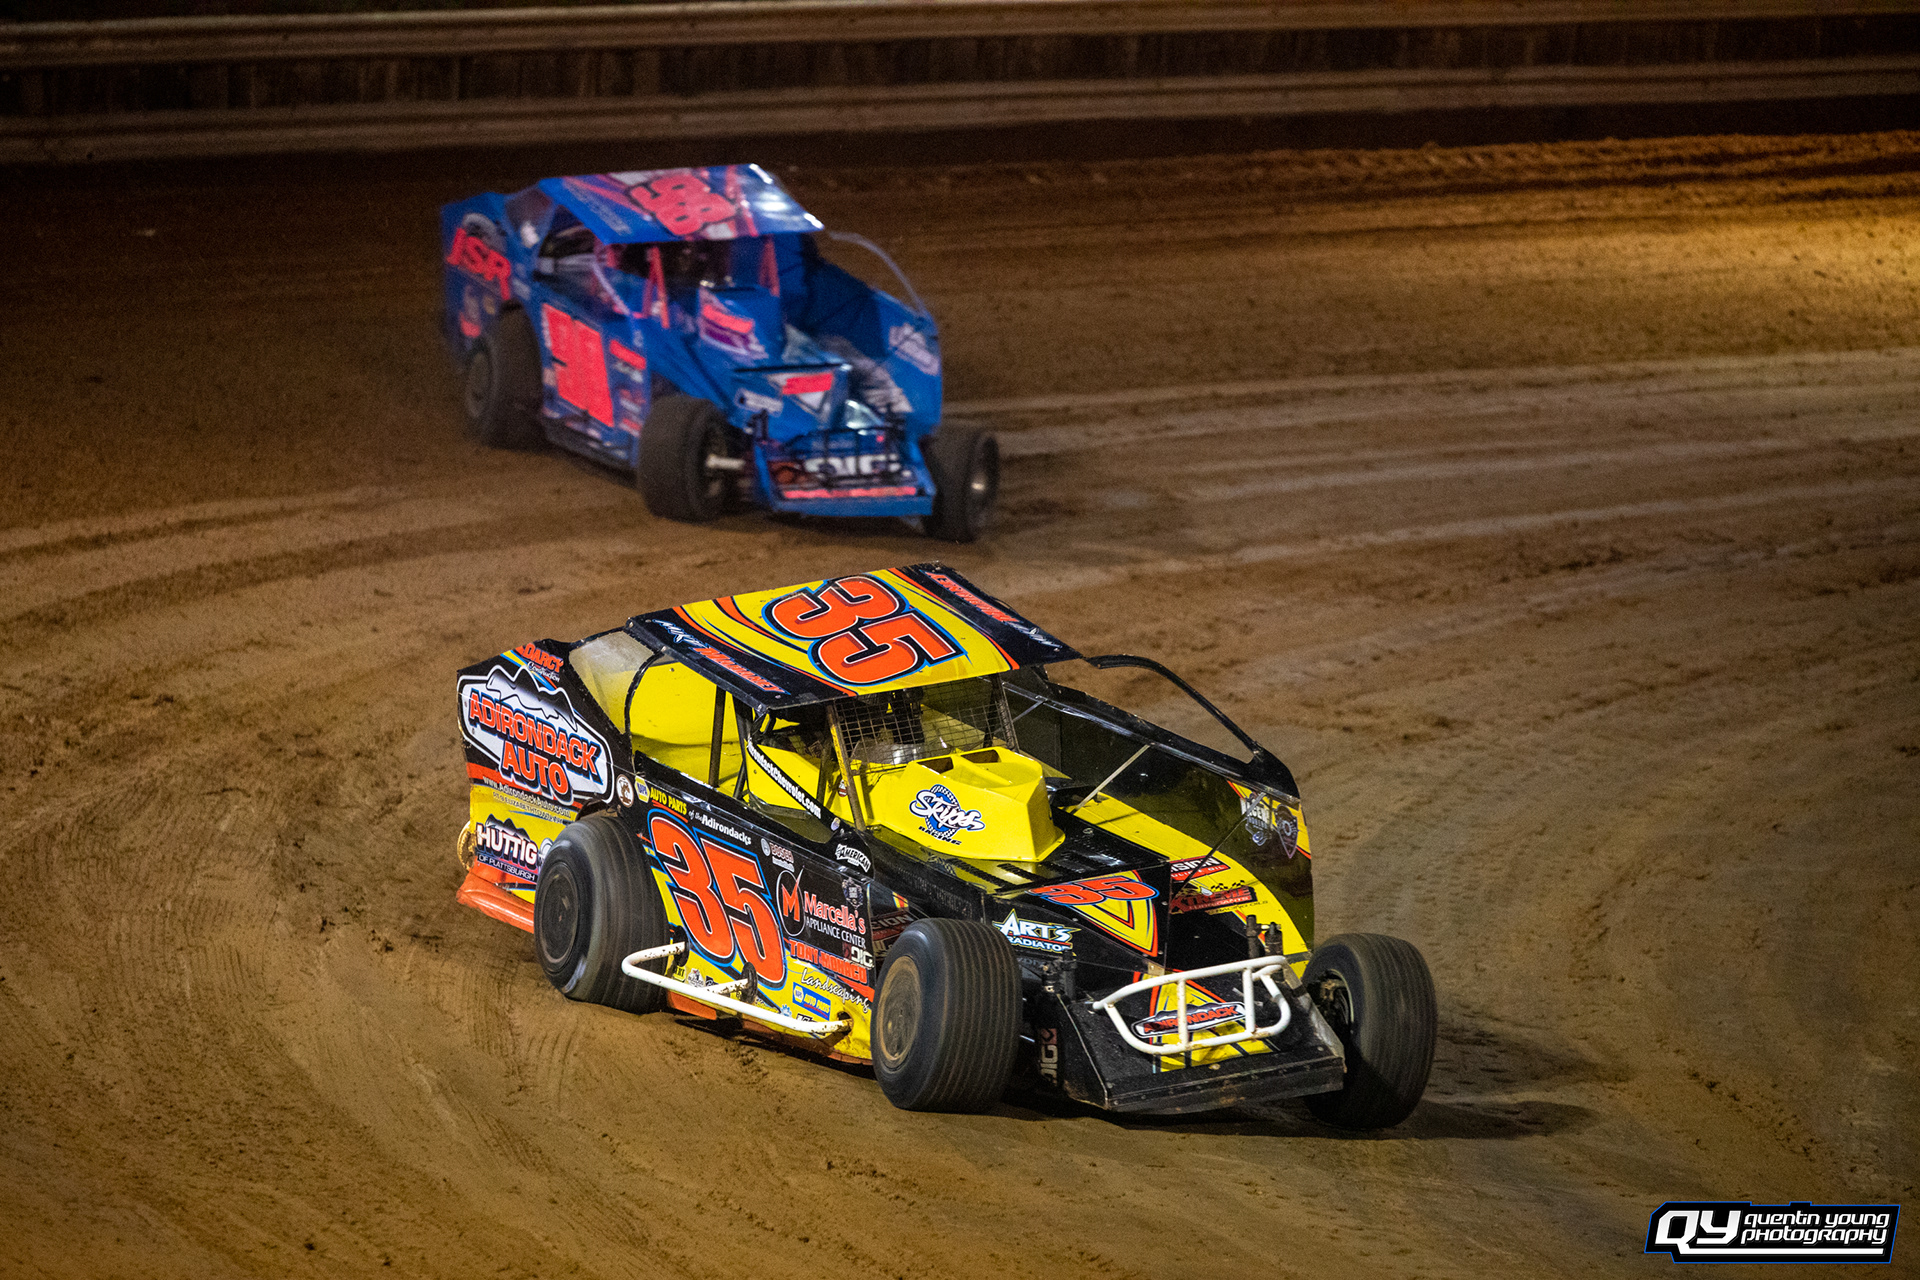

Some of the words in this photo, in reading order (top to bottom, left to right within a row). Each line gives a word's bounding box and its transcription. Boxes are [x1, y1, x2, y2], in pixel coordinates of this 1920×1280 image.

[772, 575, 957, 684] 35
[522, 642, 564, 673] DARCY
[469, 690, 600, 778] ADIRONDACK
[502, 740, 571, 796] AUTO
[650, 787, 667, 806] AUTO
[668, 795, 687, 815] PARTS
[476, 823, 538, 866] HUTTIG
[701, 814, 752, 846] Adirondacks
[918, 826, 962, 845] RACING
[478, 854, 488, 862] OF
[488, 857, 536, 881] PLATTSBURGH
[838, 846, 870, 872] AMERICAN
[650, 816, 785, 985] 35
[1028, 876, 1156, 905] 35
[803, 890, 866, 935] Marcella's
[993, 911, 1074, 942] ART'S
[804, 916, 841, 940] APPLIANCE
[840, 930, 867, 950] CENTER
[788, 938, 819, 965] TONY
[801, 967, 871, 1014] Landscaping
[1144, 1005, 1239, 1033] ADIRNDACK
